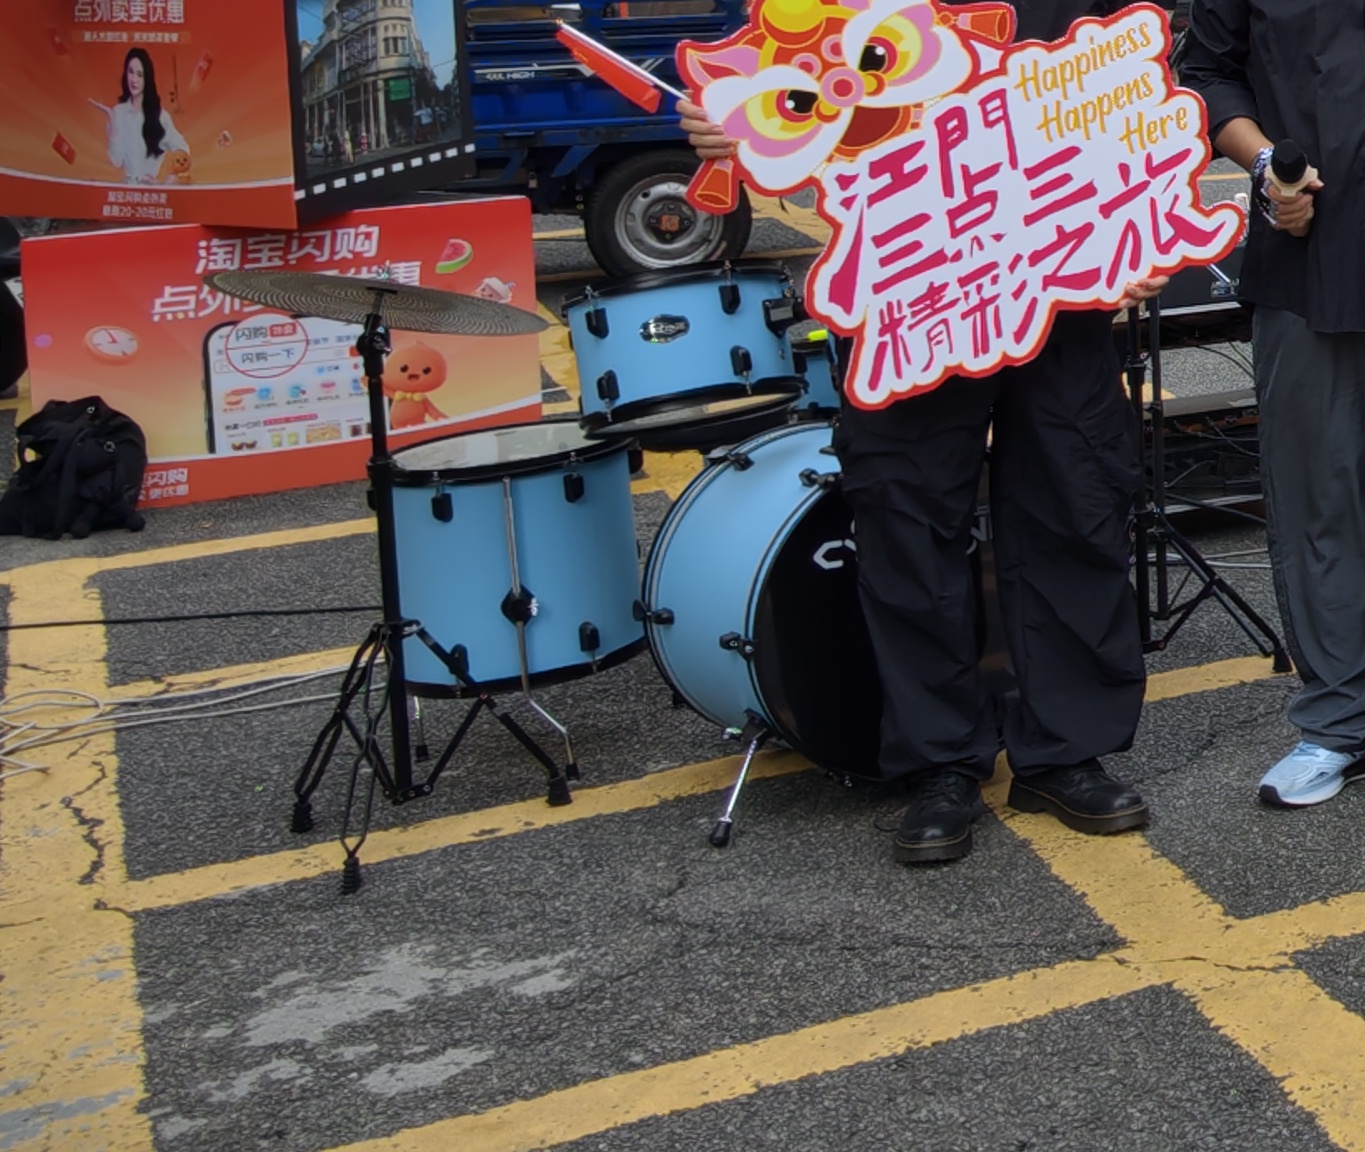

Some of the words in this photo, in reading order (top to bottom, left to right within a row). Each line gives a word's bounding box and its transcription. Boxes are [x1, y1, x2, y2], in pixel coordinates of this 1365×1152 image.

[1014, 18, 1153, 102] Happiness
[1036, 71, 1156, 142] Happens
[1118, 104, 1189, 155] Here
[871, 145, 1098, 295] 三点三
[194, 224, 380, 275] 淘宝闪购
[867, 146, 1230, 392] 精彩之旅
[234, 325, 268, 342] 闪购
[240, 347, 296, 364] 闪购一下
[139, 485, 190, 501] 更优惠
[141, 467, 189, 488] 闪购
